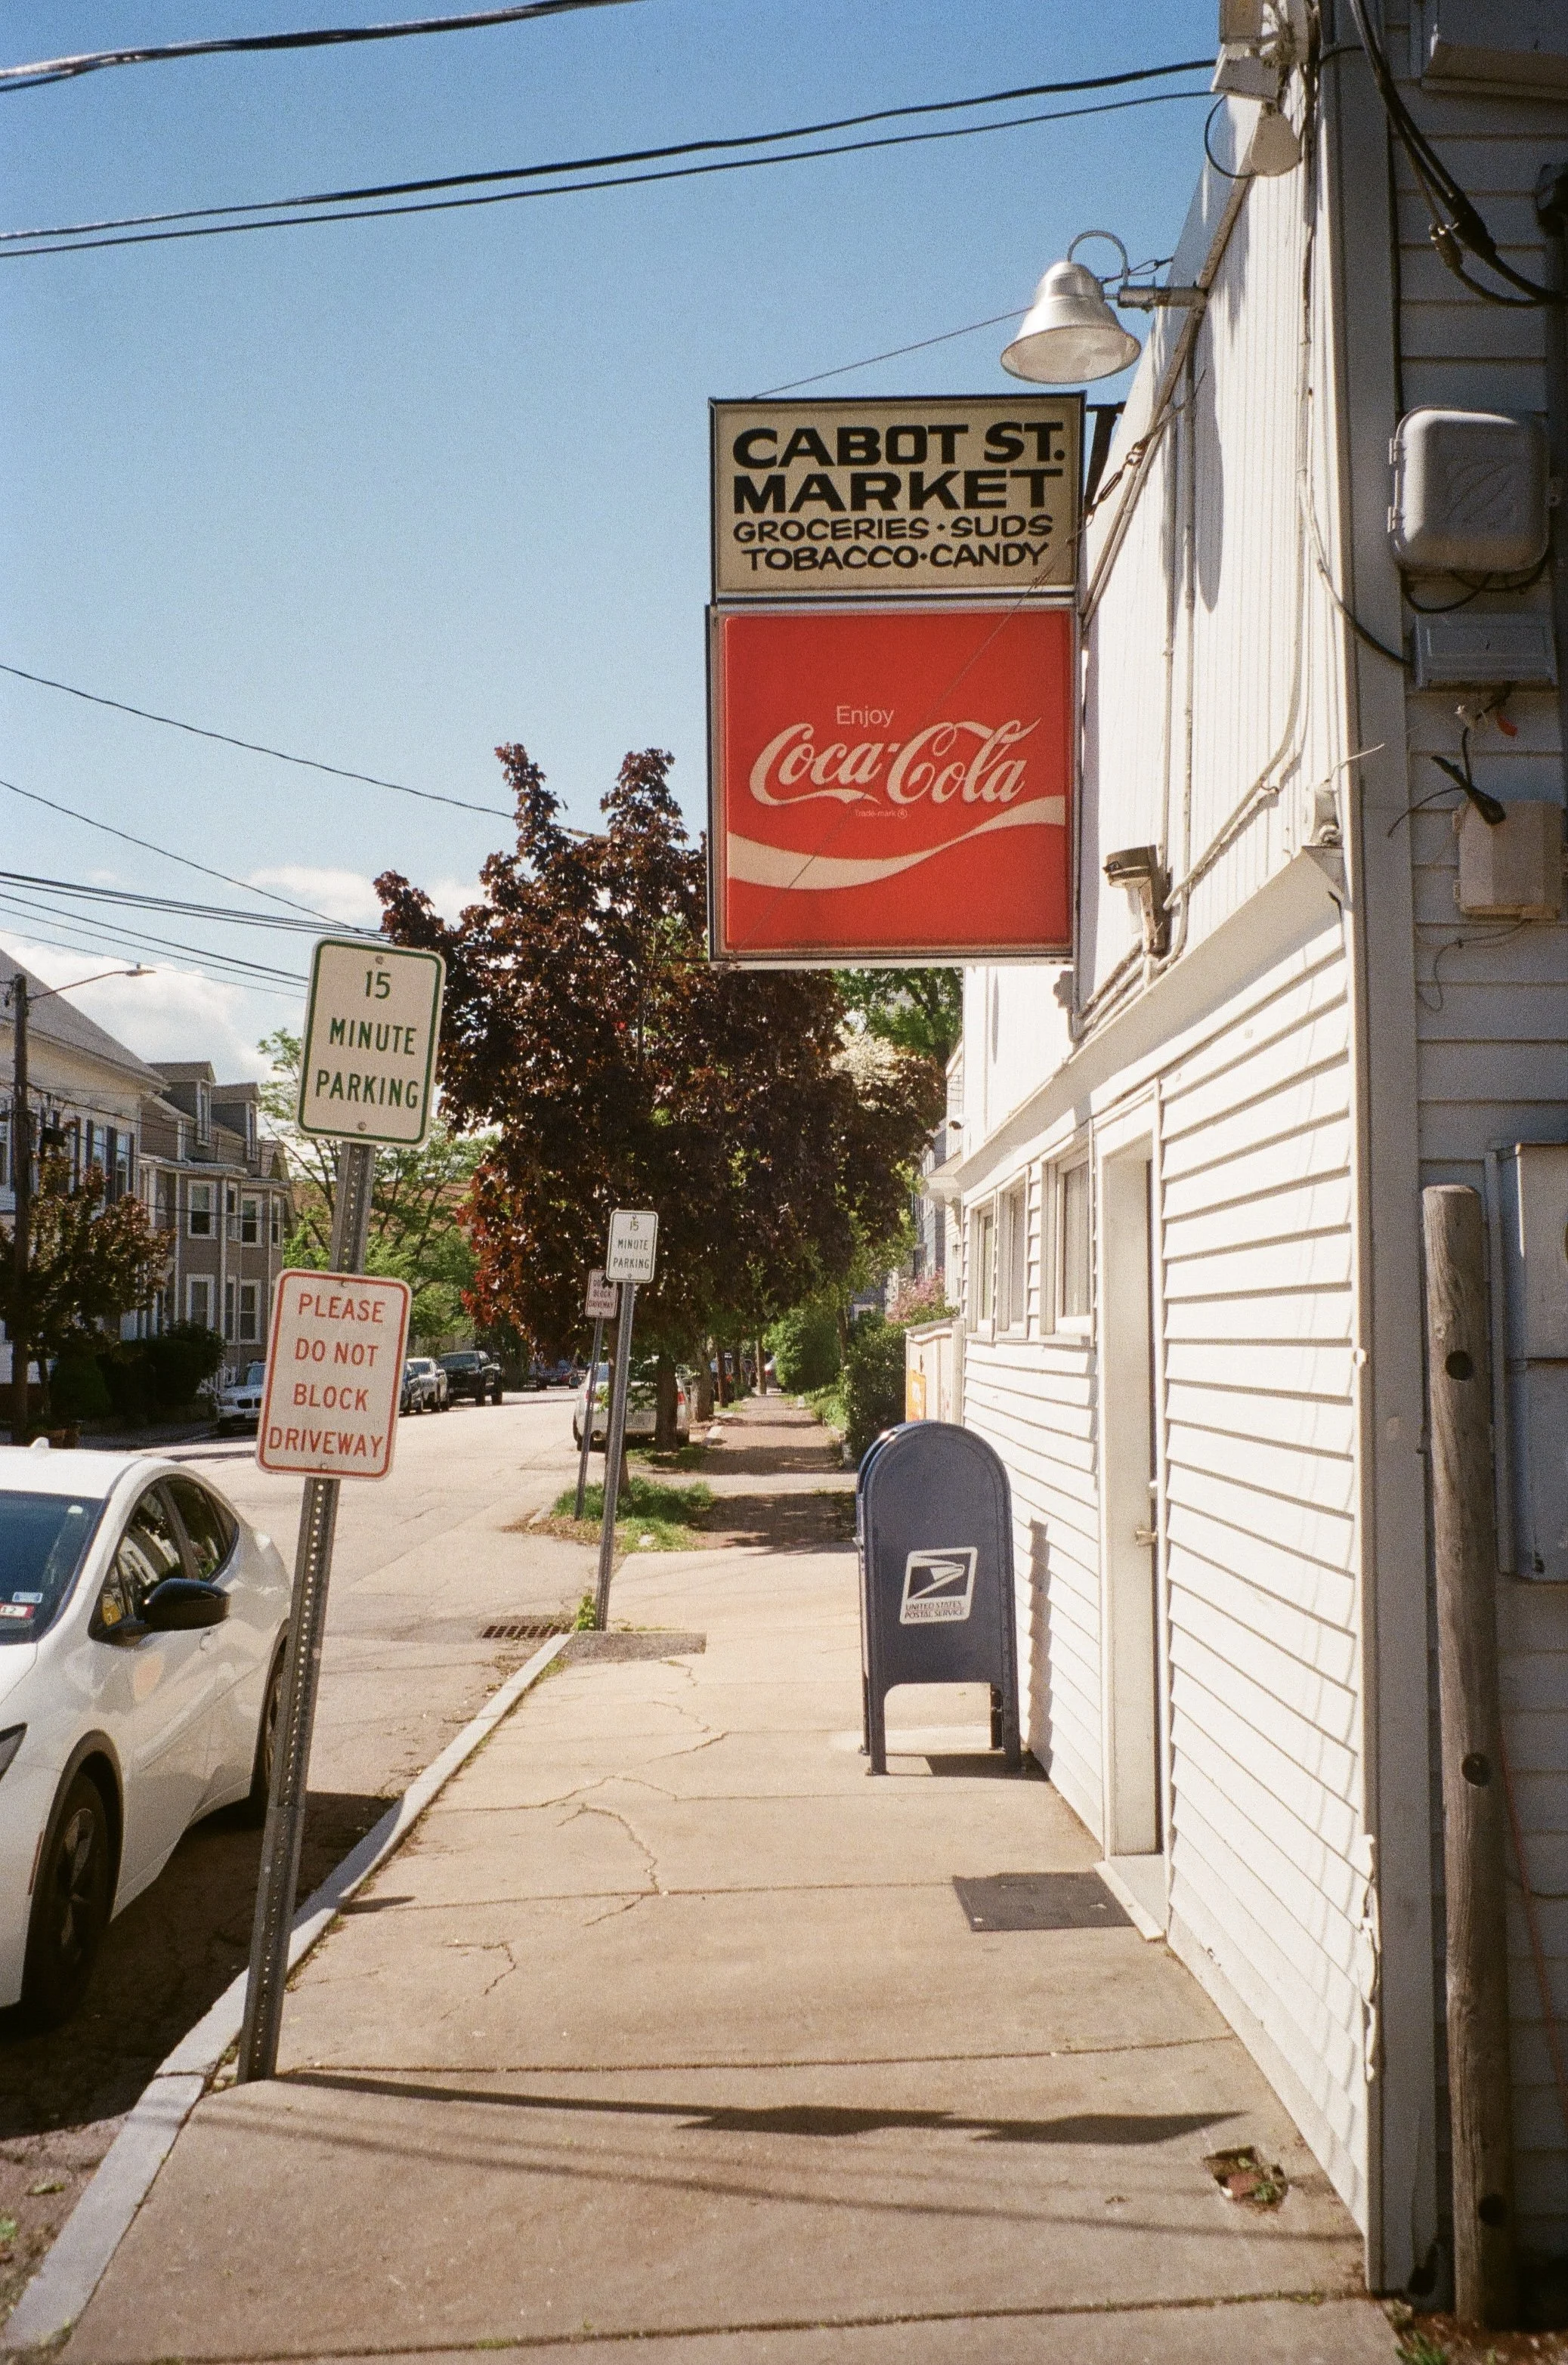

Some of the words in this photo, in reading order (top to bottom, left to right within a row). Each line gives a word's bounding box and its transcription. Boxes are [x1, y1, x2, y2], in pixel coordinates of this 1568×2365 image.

[732, 423, 969, 468] CABOT
[984, 421, 1065, 463] ST.
[733, 468, 1064, 514] MARKET
[732, 517, 929, 543] GROCERIES
[951, 514, 1053, 537] SUDS
[836, 705, 895, 728] Enjoy
[749, 717, 1041, 806] Coca-Cola
[365, 970, 391, 999] 15
[329, 1017, 417, 1055] MINUTE
[316, 1069, 419, 1108] PARKING
[629, 1220, 639, 1231] 15
[617, 1238, 649, 1251] MINUTE
[613, 1257, 650, 1269] PARKING
[298, 1293, 385, 1323] PLEASE
[295, 1337, 326, 1362] DO
[334, 1341, 379, 1367] NOT
[292, 1383, 370, 1411] BLOCK
[268, 1426, 383, 1458] DRIVEWAY
[905, 1610, 932, 1618] POSTAL
[936, 1600, 962, 1609] STATES
